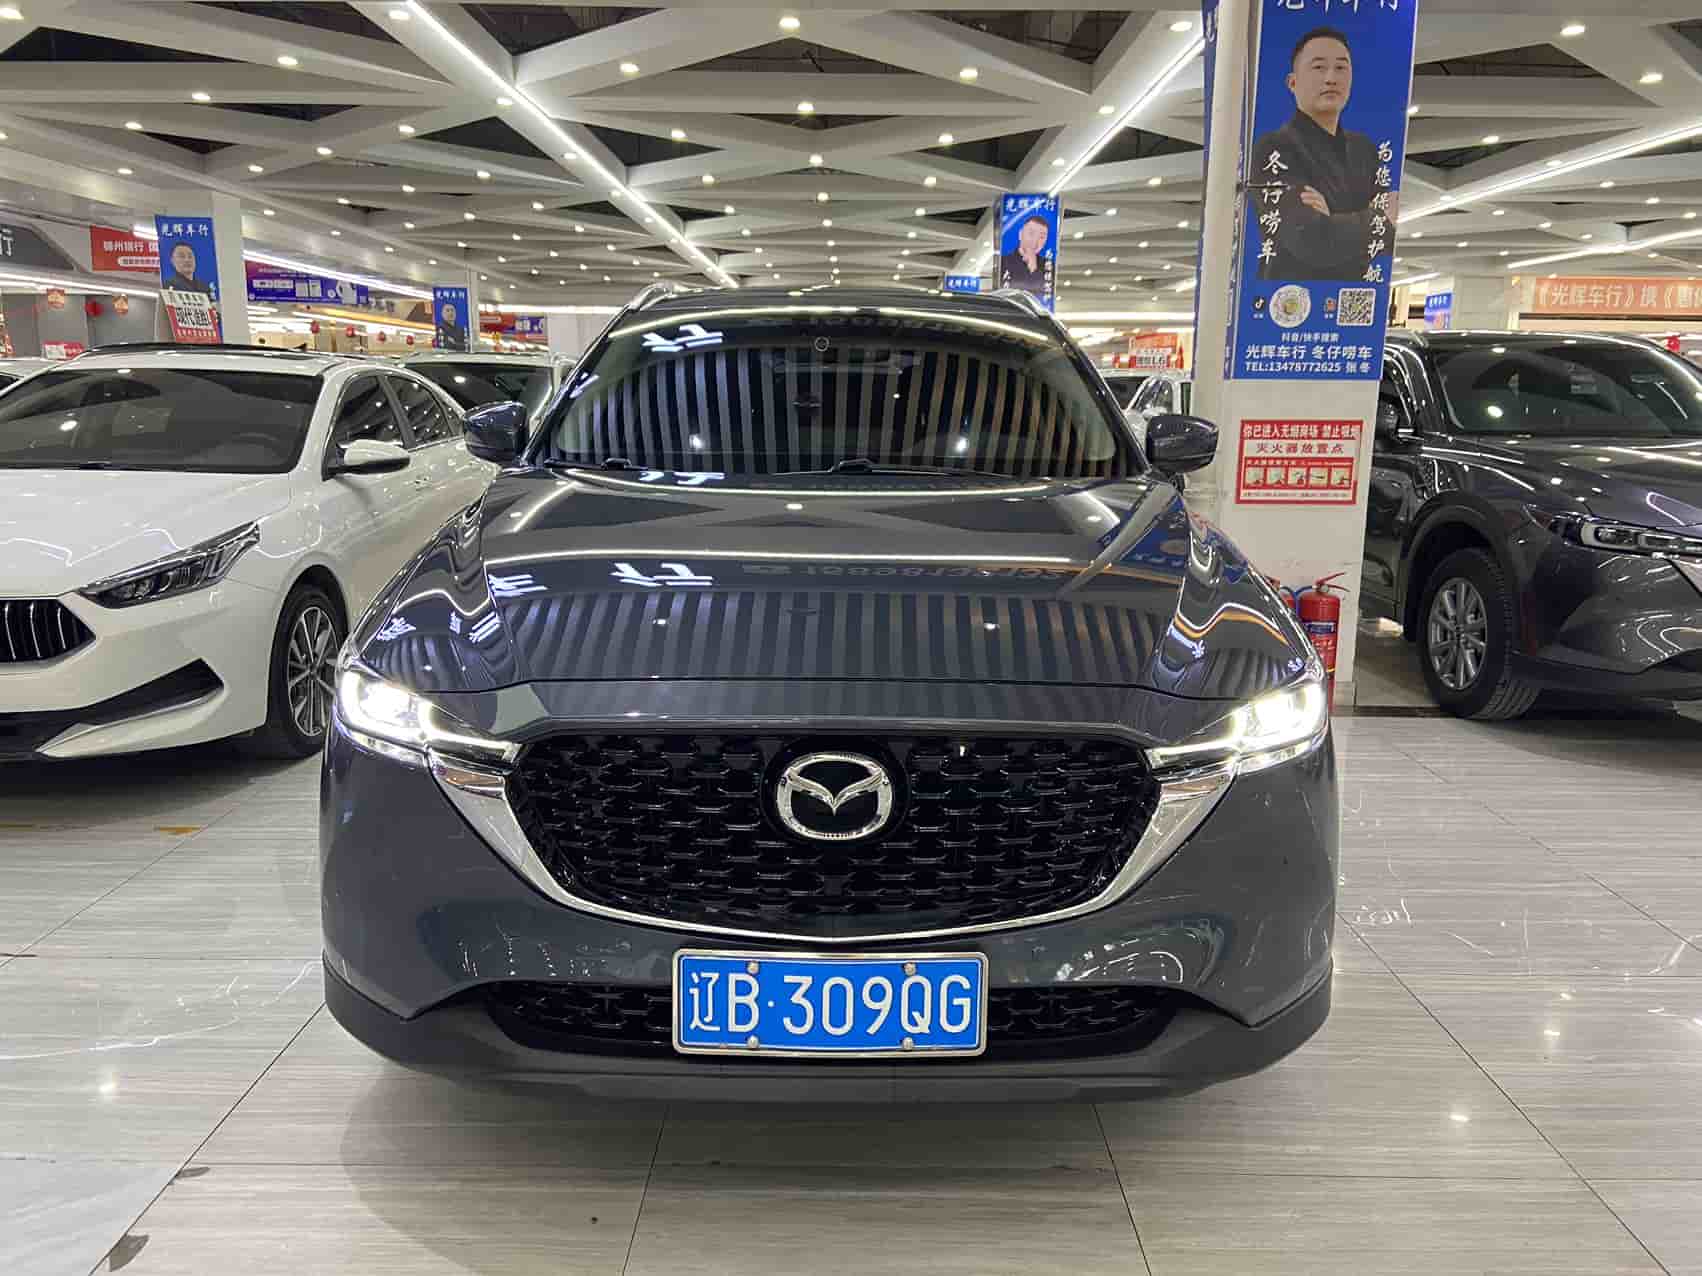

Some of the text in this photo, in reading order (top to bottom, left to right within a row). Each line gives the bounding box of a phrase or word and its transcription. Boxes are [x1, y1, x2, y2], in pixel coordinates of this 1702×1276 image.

[1362, 141, 1393, 284] 为您保驾护航
[1245, 345, 1374, 361] 光辉车行 冬仔唠车
[688, 971, 972, 1036] 辽B·309QG
